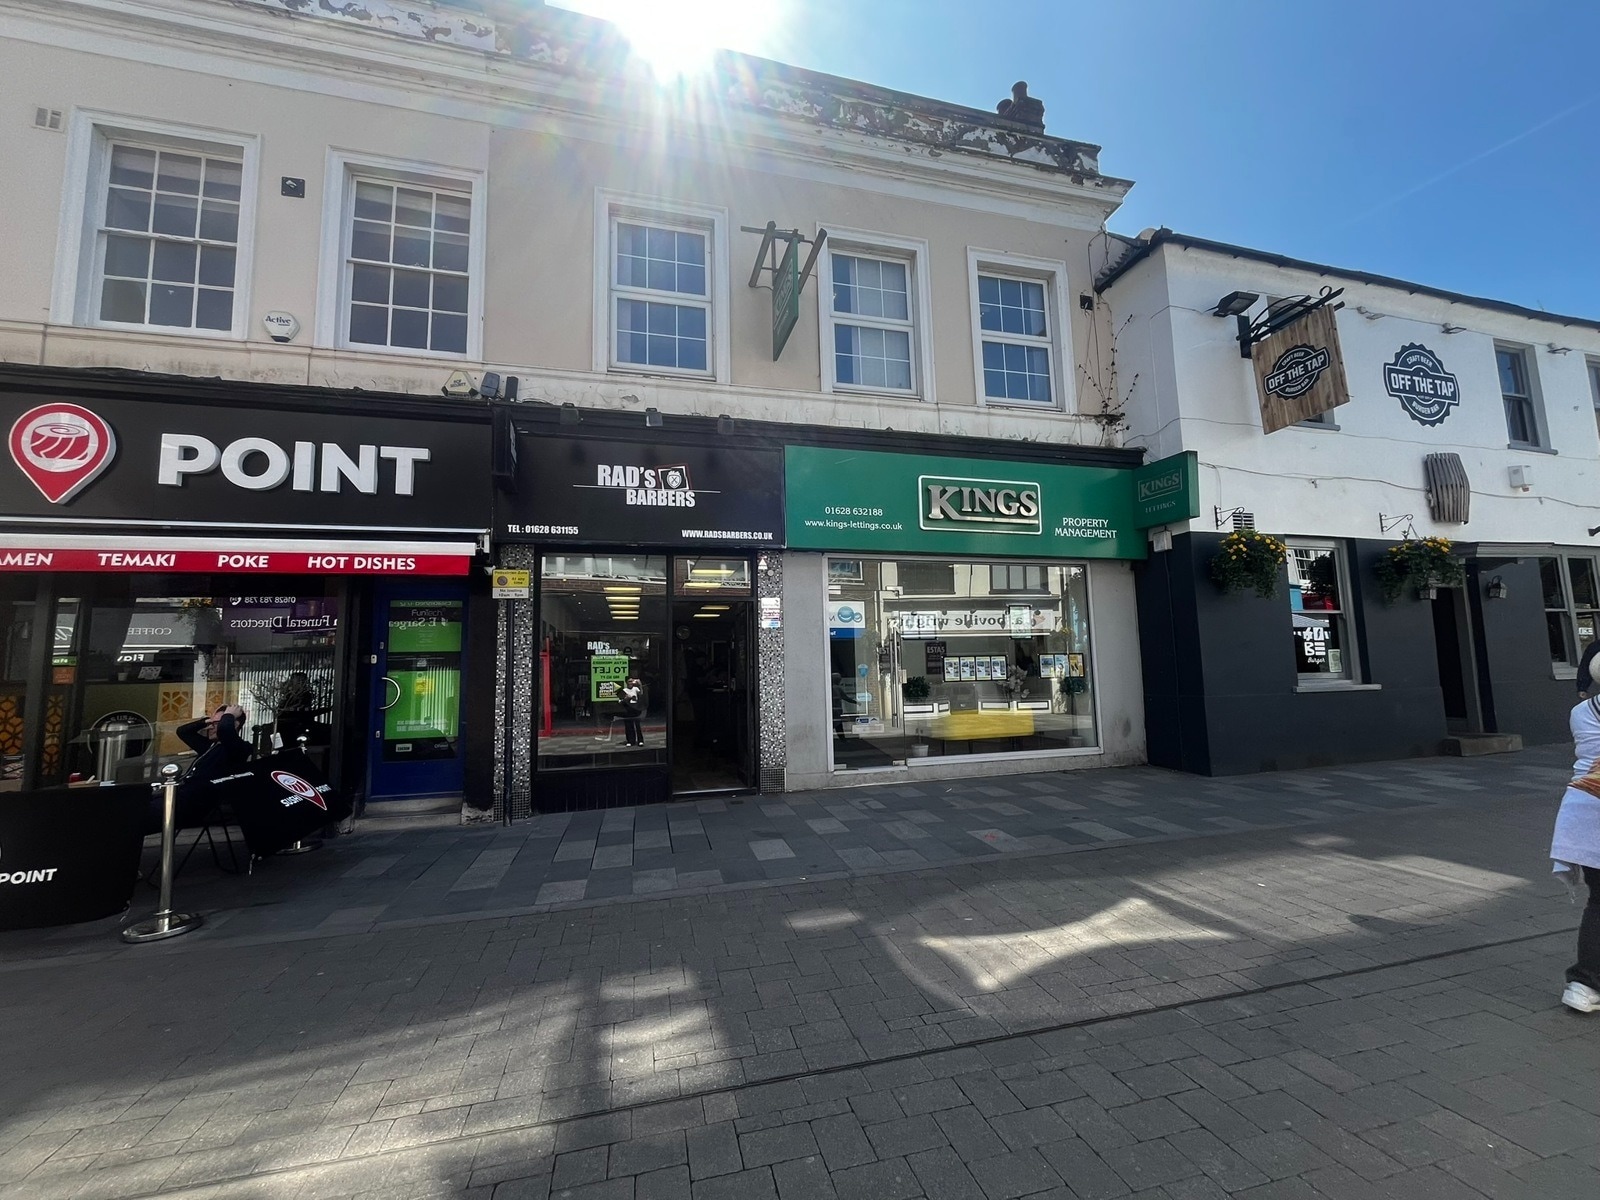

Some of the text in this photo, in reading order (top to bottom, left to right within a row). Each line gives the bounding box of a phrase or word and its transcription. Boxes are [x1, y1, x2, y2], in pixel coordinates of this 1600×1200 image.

[265, 315, 291, 324] Active
[1406, 354, 1433, 368] CRAFT BEER
[1268, 373, 1286, 389] OFF
[1286, 363, 1305, 380] THE
[1306, 354, 1325, 371] TAP
[1390, 372, 1455, 397] OFF THE TAP
[1430, 403, 1440, 414] BAR
[158, 432, 431, 496] POINT
[1140, 472, 1180, 498] KINGS
[626, 488, 695, 508] BARBERS
[926, 483, 1039, 523] KINGS
[824, 506, 883, 517] 01628 632188
[1145, 500, 1176, 514] LETTINGS
[804, 519, 903, 531] www.kings-lettings.co.uk
[1062, 517, 1109, 529] PROPERTY
[525, 525, 550, 534] 01628
[550, 525, 579, 535] 631155
[681, 529, 773, 540] WWW.RADSBARBERS.CO.UK
[1054, 527, 1117, 539] MANAGEMENT
[0, 552, 416, 570] MEN TEMAKI POKE HOT DISHES
[411, 609, 443, 617] FunTech
[926, 646, 945, 654] ESTAS
[0, 867, 58, 885] POINT
